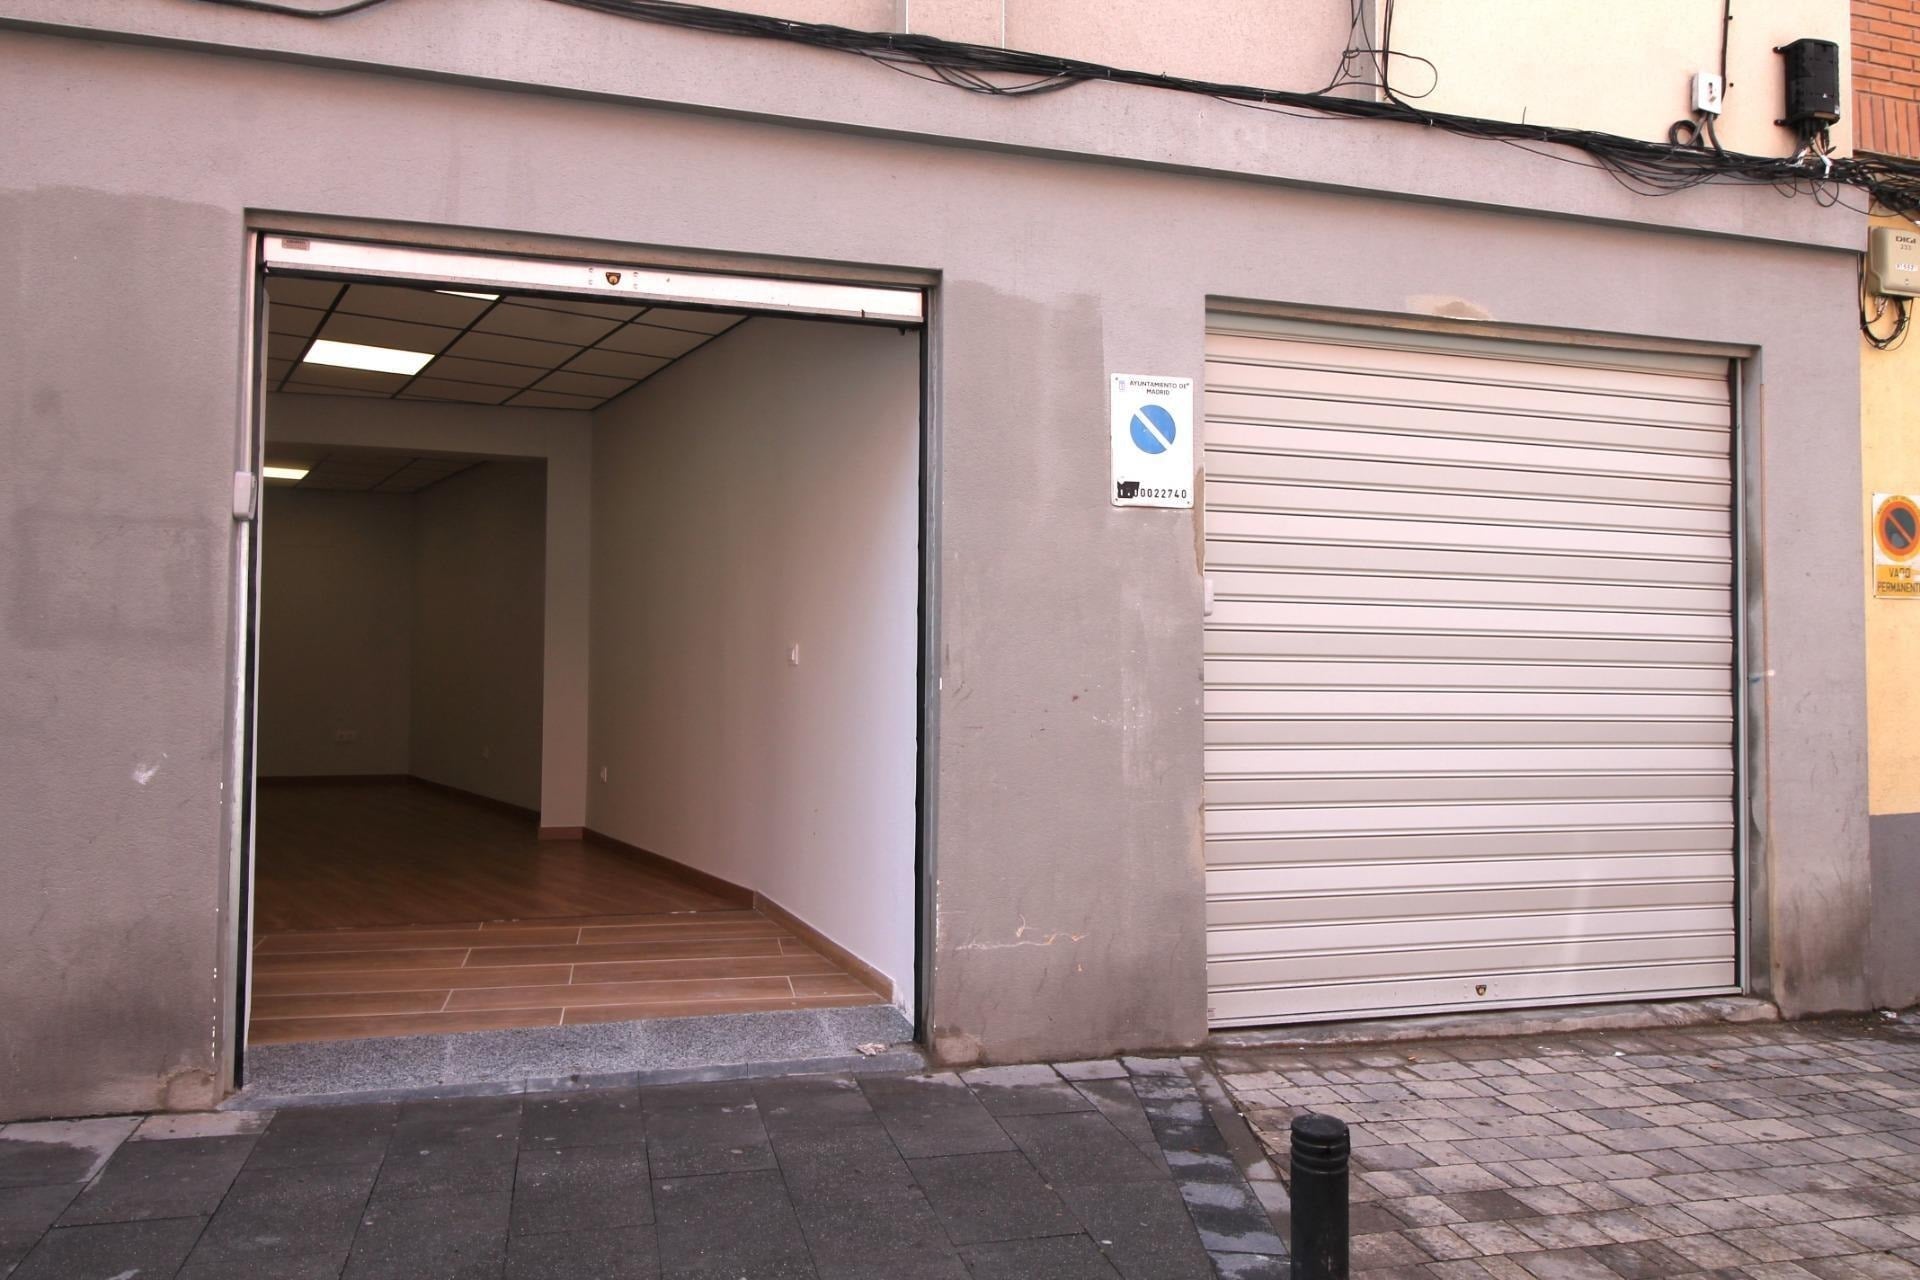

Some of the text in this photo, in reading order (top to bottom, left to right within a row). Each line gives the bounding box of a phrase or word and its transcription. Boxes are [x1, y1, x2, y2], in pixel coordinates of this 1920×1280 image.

[1130, 380, 1178, 389] AYUNTAMIENTO
[1146, 388, 1170, 396] MADRID
[1876, 580, 1920, 593] PERMANENT
